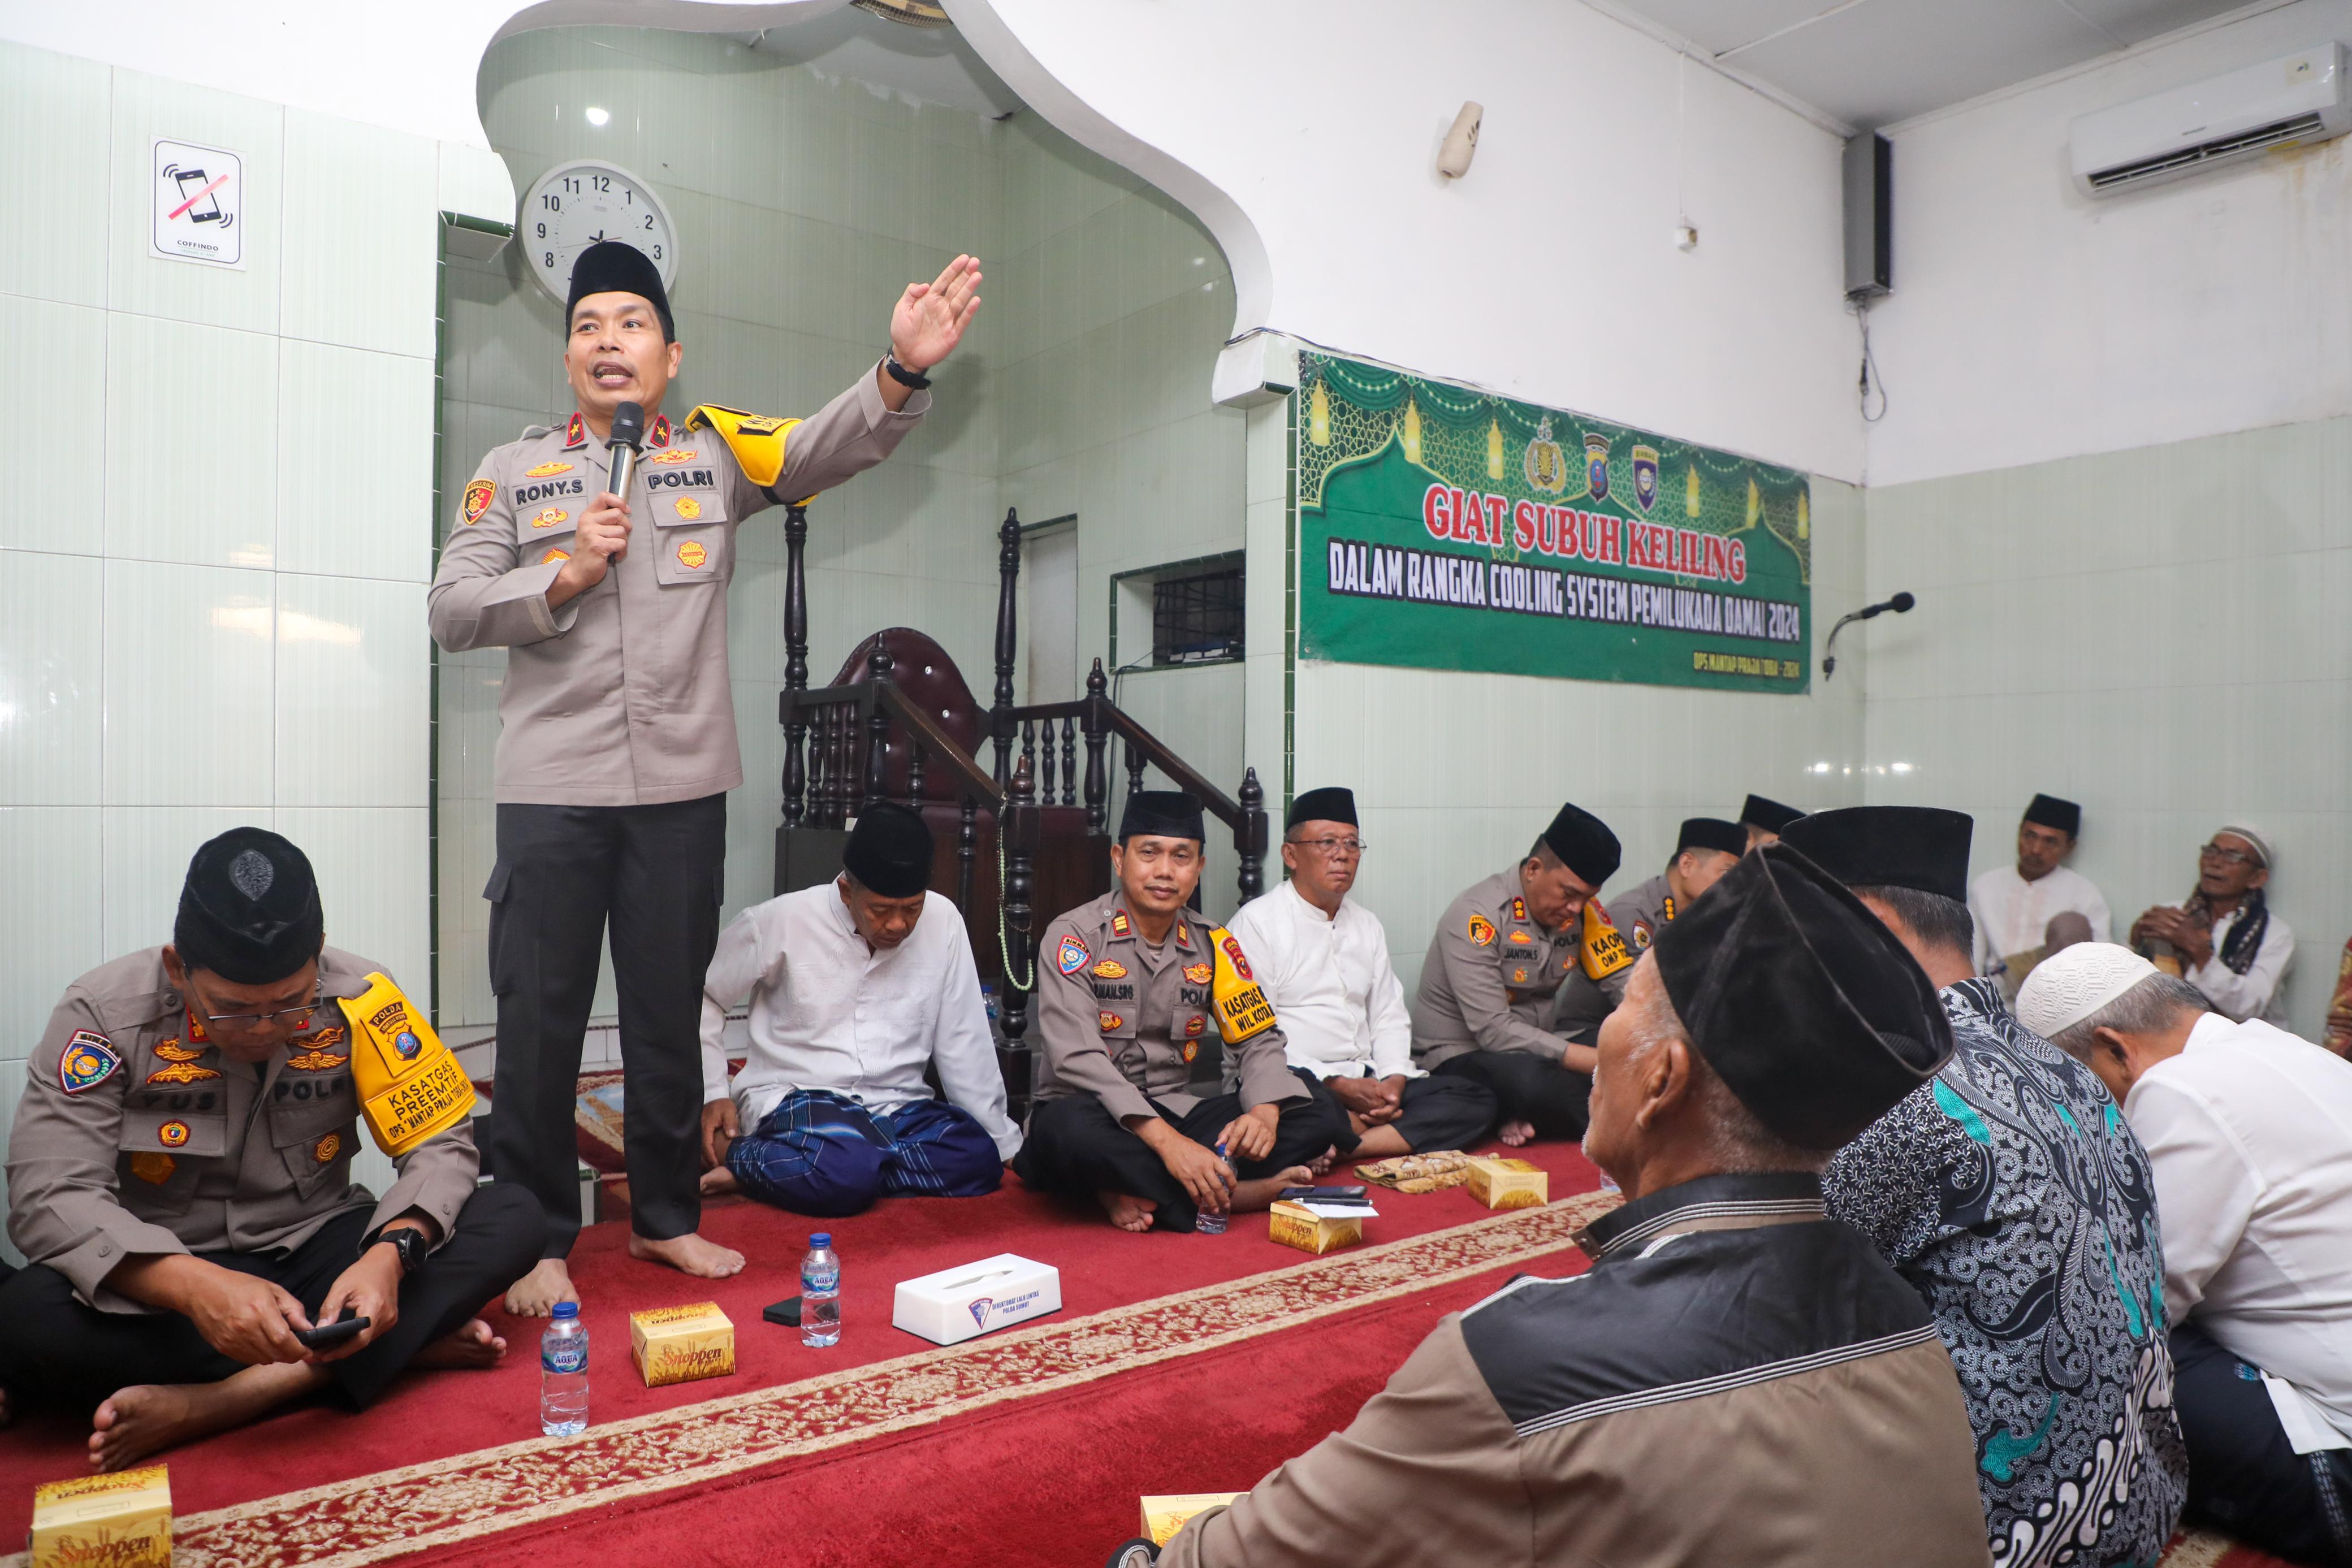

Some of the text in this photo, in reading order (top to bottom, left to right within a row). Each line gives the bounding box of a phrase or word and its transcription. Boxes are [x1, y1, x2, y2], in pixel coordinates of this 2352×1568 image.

[563, 177, 580, 194] 11
[592, 175, 609, 192] 12
[542, 194, 560, 211] 10
[625, 190, 631, 205] 1
[537, 223, 546, 239] 9
[645, 215, 653, 230] 2
[178, 240, 219, 251] COFFINDO
[654, 245, 662, 260] 3
[546, 252, 554, 267] 8
[648, 470, 714, 490] POLRI
[516, 479, 583, 505] RONY.S
[1424, 483, 1746, 583] GIAT SUBUH KELILING
[1330, 542, 1800, 641] DALAM RANGKA COOLING SYSTEM PEMILUKADA DAMAI 2024
[1223, 987, 1261, 1019] KASATGAS
[373, 1003, 401, 1024] POLDA
[1235, 1014, 1255, 1032] WIL
[1252, 1006, 1272, 1024] KOTA
[388, 1060, 453, 1108] KASATGAS
[395, 1071, 459, 1120] PREEMTIF
[389, 1124, 405, 1138] OPS
[434, 1093, 454, 1112] PRAJA
[814, 1276, 833, 1285] AQUA
[992, 1297, 1016, 1310] DIREKTORAT
[1017, 1294, 1026, 1303] LALU
[1026, 1290, 1040, 1300] LINTAS
[1003, 1301, 1030, 1315] POLDA SUMUT
[555, 1354, 578, 1365] AQUA
[664, 1348, 722, 1366] Snoppen
[59, 1536, 150, 1563] Snoppen
